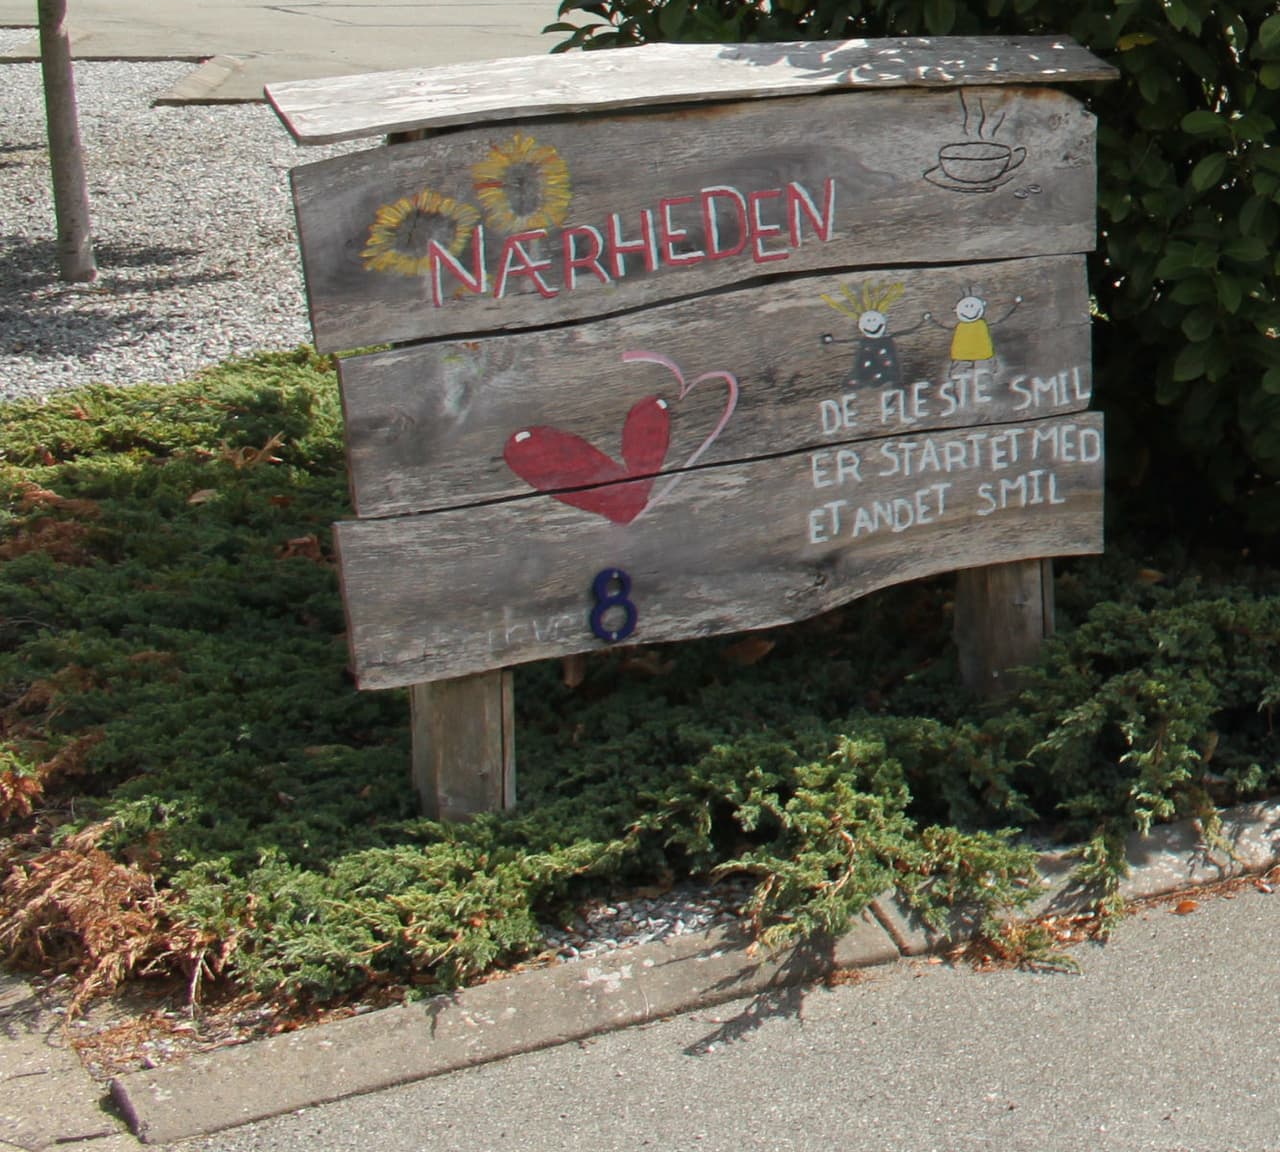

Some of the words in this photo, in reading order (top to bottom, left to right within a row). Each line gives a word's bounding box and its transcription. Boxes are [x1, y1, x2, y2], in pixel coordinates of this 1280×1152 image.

[429, 178, 835, 308] NÆRHEDEN
[819, 393, 858, 436] DE
[880, 368, 993, 425] FLESTE
[1009, 367, 1092, 412] SMIL
[811, 450, 862, 489] ER
[878, 428, 1026, 477] STARTET
[1031, 424, 1101, 463] MED
[809, 499, 848, 545] ET
[852, 482, 952, 538] ANDET
[976, 469, 1066, 517] SMIL
[590, 567, 638, 643] 8
